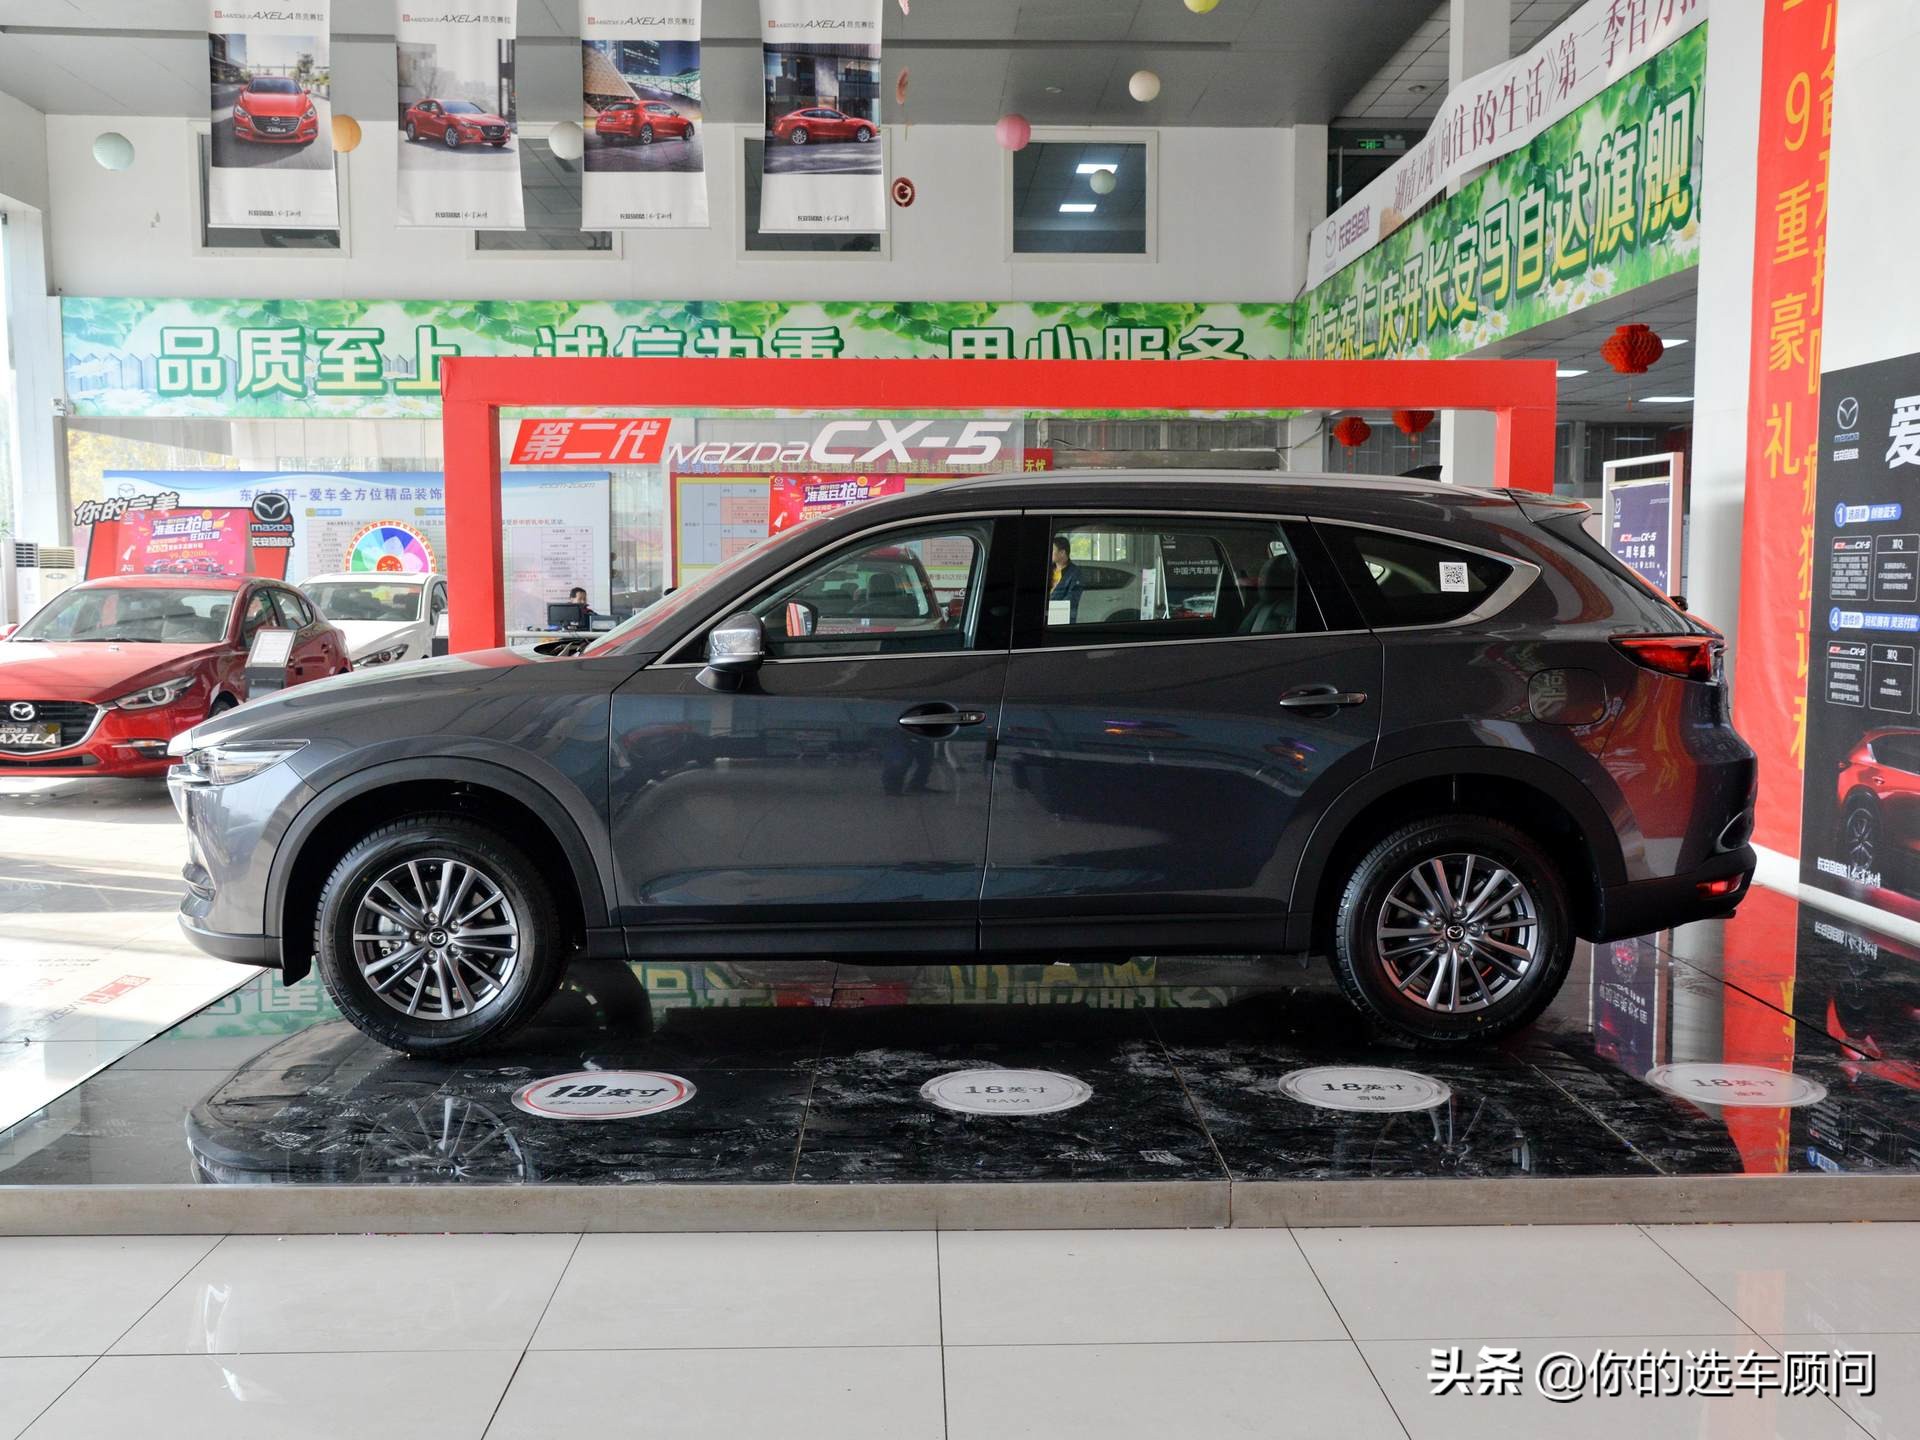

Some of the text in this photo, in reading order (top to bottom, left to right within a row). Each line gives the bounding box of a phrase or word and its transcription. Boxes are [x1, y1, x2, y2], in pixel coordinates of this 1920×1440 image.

[252, 11, 294, 20] AXELA
[440, 14, 481, 24] AXELA
[624, 17, 666, 26] AXELA
[805, 20, 847, 29] AXELA
[1305, 88, 1703, 360] 北京东仁庆开长安马自达旗舰
[157, 326, 461, 397] 品质至上
[519, 421, 661, 461] 第二代
[810, 420, 1012, 465] CX-5
[0, 733, 56, 744] AXELA
[546, 1085, 667, 1098] 19英寸
[964, 1085, 1048, 1094] 18英寸
